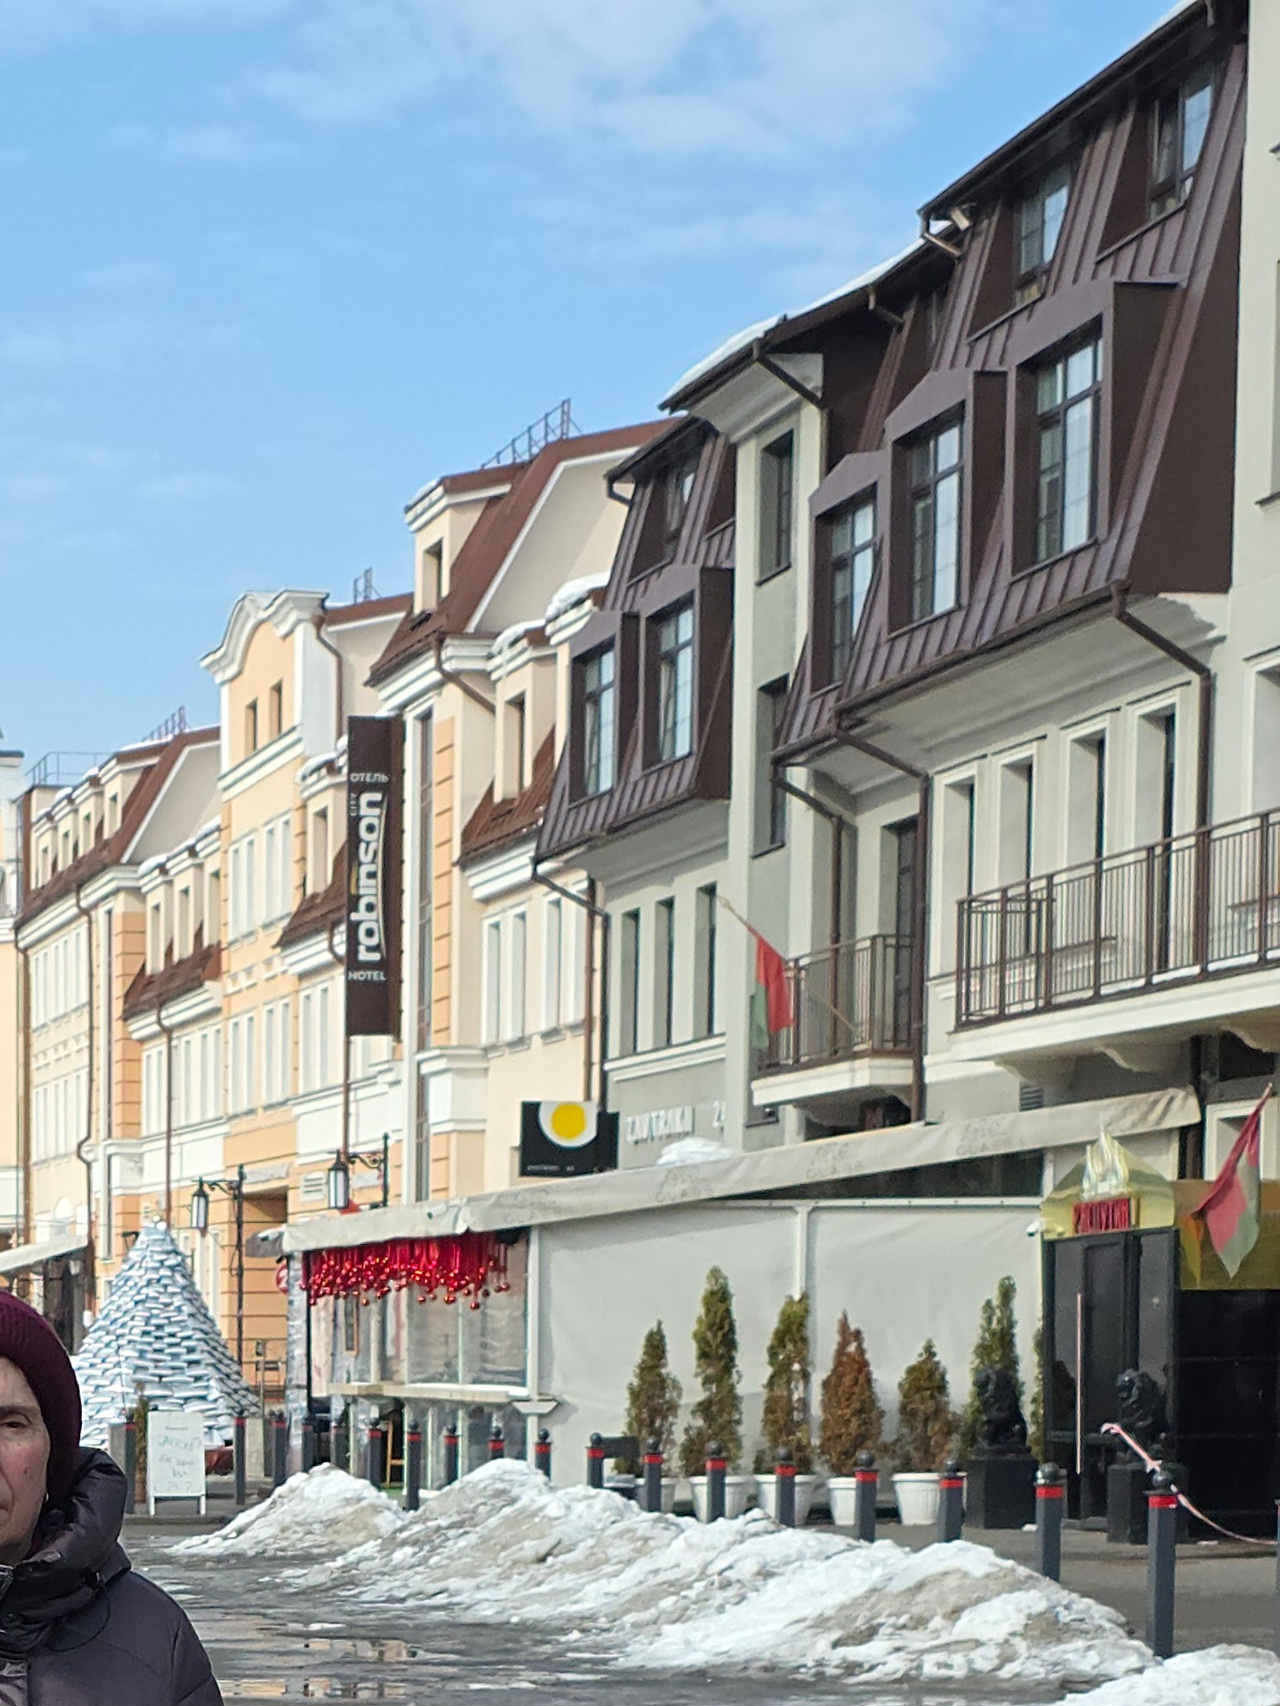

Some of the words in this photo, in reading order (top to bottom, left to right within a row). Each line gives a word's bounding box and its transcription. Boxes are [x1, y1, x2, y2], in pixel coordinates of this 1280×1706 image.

[350, 772, 389, 783] ОТЕЛЬ
[349, 791, 384, 962] robinson
[348, 969, 387, 982] HOTEL
